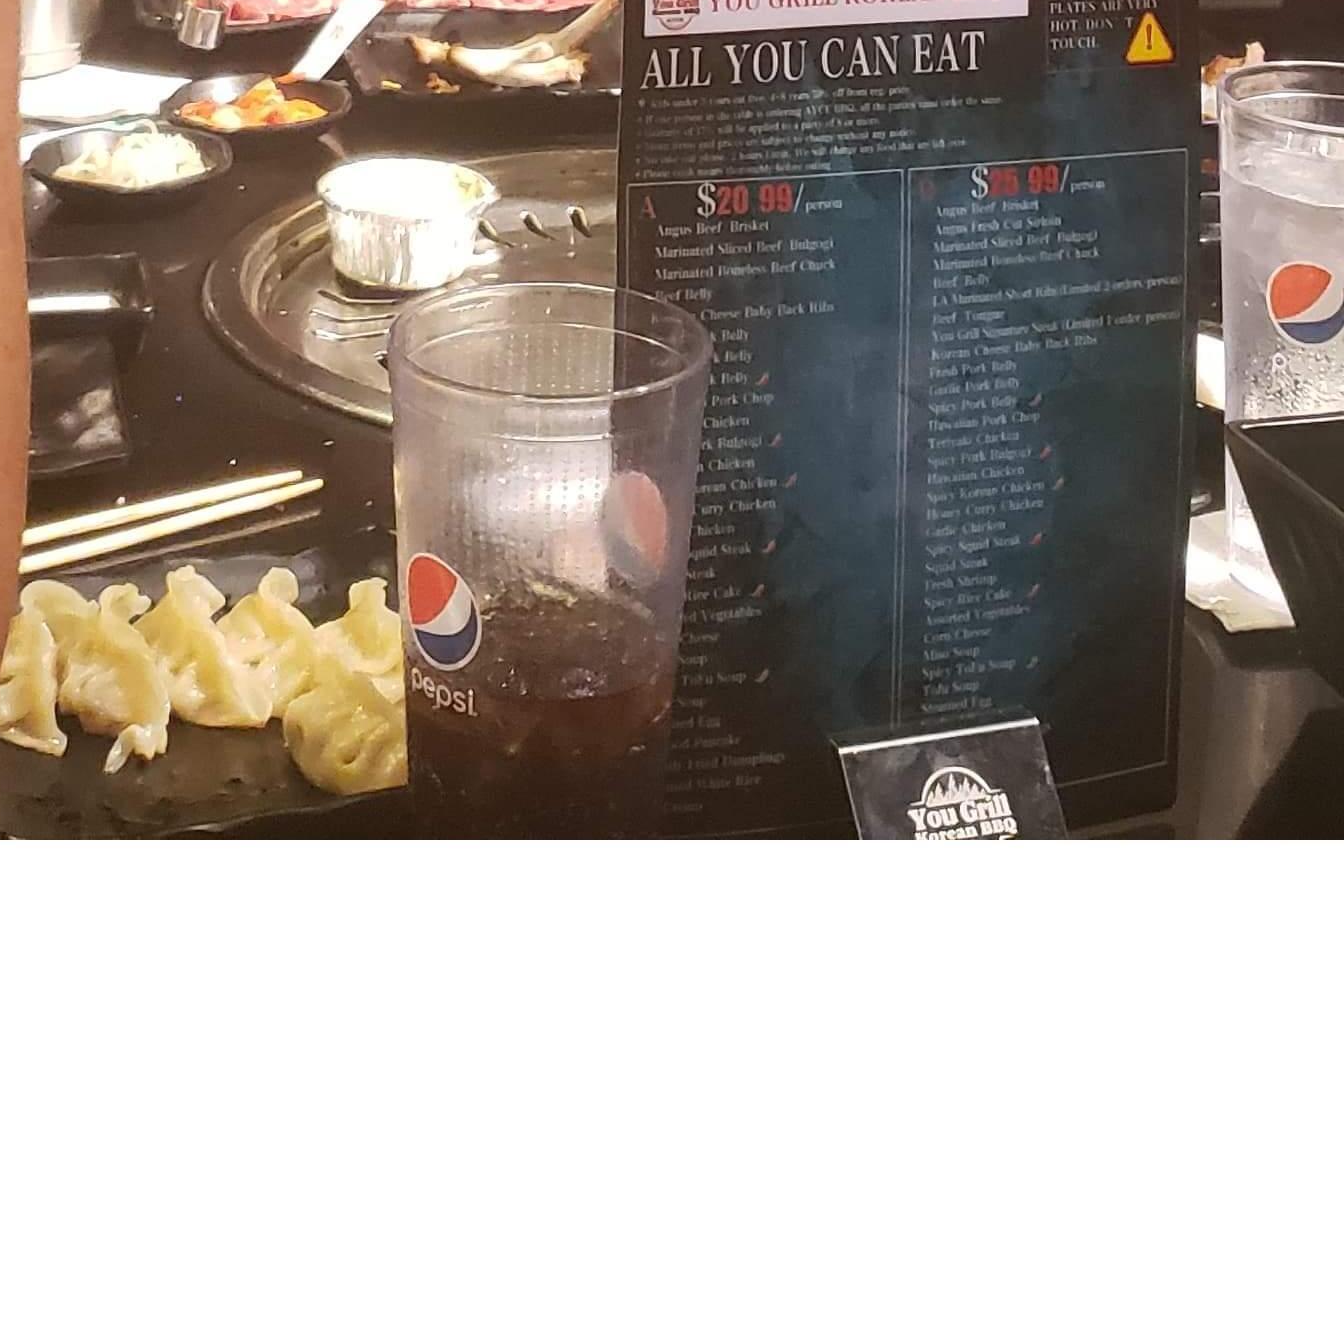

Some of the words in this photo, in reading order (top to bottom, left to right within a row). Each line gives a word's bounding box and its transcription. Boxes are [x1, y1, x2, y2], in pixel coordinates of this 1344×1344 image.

[1049, 1, 1096, 14] PLATES
[1102, 0, 1123, 12] ARE
[640, 46, 712, 90] ALL
[724, 40, 808, 84] YOU
[821, 35, 901, 80] CAN
[912, 30, 985, 75] EAT
[642, 196, 656, 218] A
[657, 223, 692, 238] Angus
[696, 220, 723, 234] Beef
[730, 218, 769, 233] Brisket
[655, 242, 714, 259] Marinated
[718, 240, 752, 255] Sliced
[757, 238, 783, 253] Beef
[790, 235, 834, 251] Bulgogi
[933, 237, 988, 253] Marinated
[655, 264, 714, 281] Marinated
[718, 262, 768, 278] Boneless
[771, 260, 797, 274] Beef
[800, 257, 836, 272] Chuck
[933, 255, 988, 271] Marinated
[685, 286, 713, 303] Belly
[700, 308, 741, 322] Cheese
[744, 305, 772, 320] Baby
[777, 302, 805, 317] Back
[809, 300, 835, 314] Ribs
[721, 328, 750, 343] Belly
[724, 349, 753, 364] Belly
[721, 370, 749, 385] Belly
[711, 393, 739, 408] Pork
[703, 415, 751, 429] Chicken
[707, 456, 756, 472] Chicken
[980, 465, 1025, 480] Chicken
[730, 476, 778, 491] Chicken
[728, 498, 777, 513] Chicken
[410, 667, 479, 717] pepsi
[907, 805, 959, 832] You
[959, 792, 1013, 825] Grill
[980, 816, 1019, 838] BBQ
